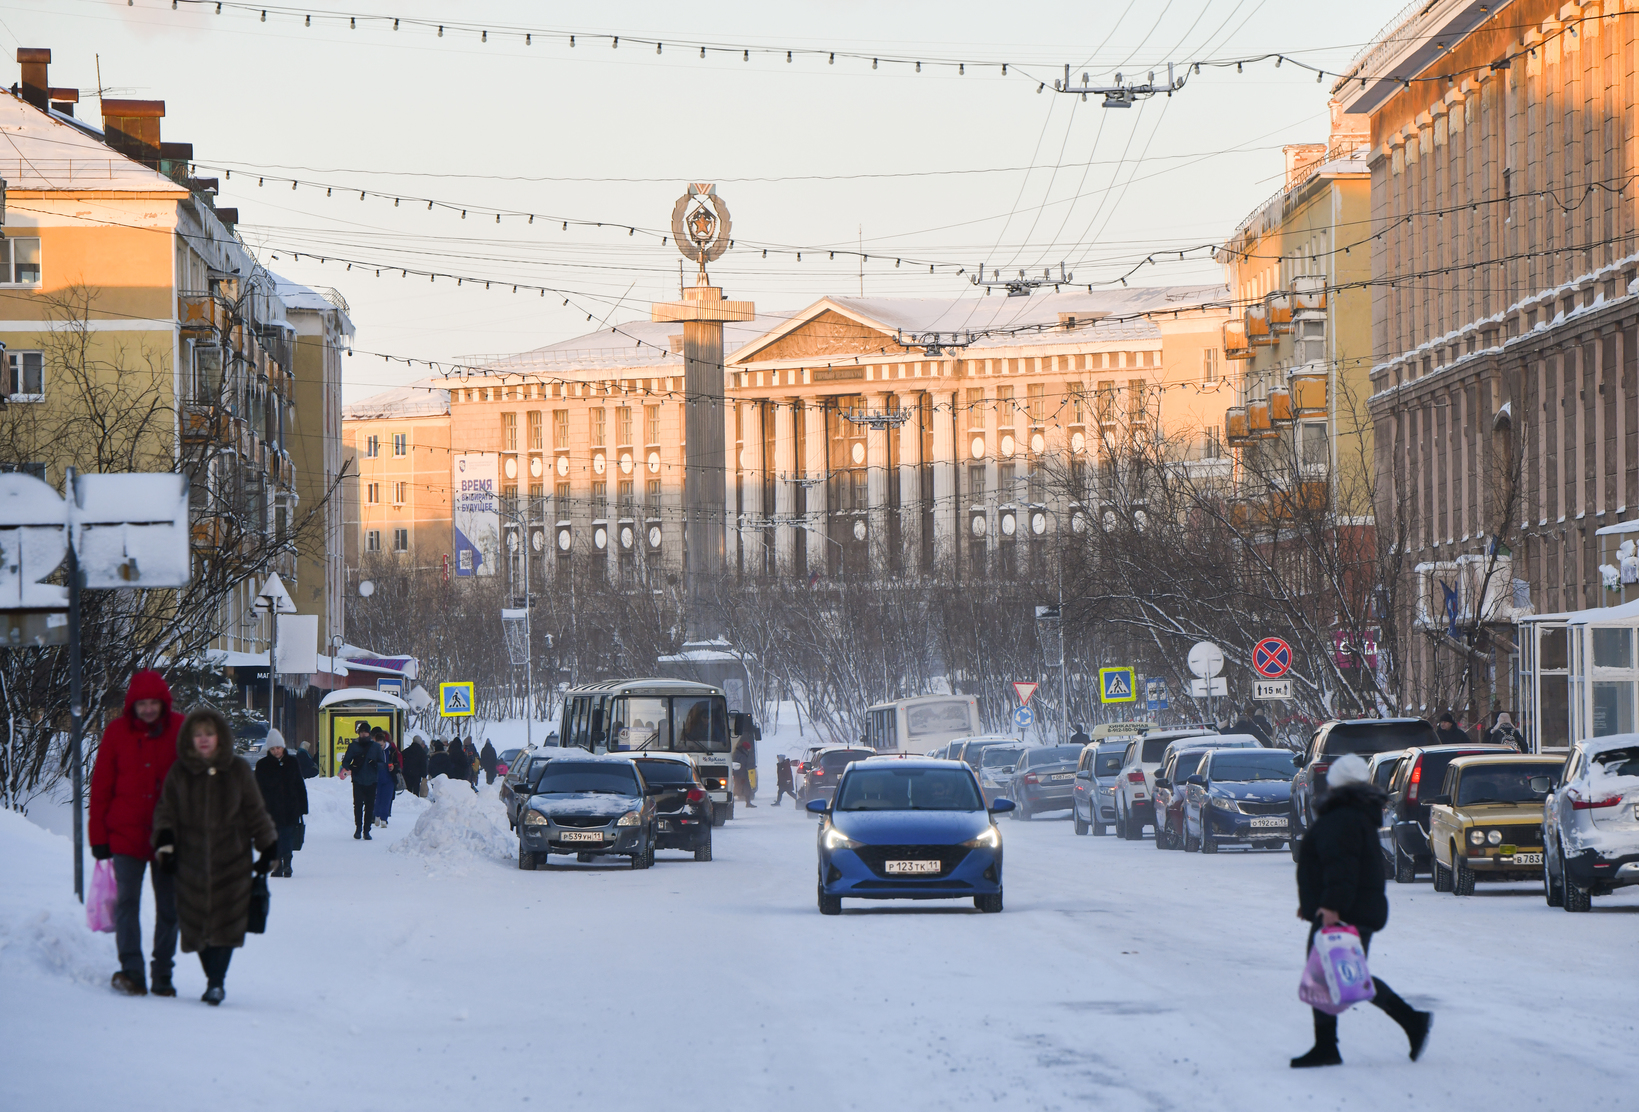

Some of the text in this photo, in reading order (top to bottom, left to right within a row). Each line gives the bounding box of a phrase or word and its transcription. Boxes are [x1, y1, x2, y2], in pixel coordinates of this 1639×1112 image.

[461, 479, 492, 491] ВРЕМЯ
[461, 491, 494, 502] ВЫБИРАТЬ
[461, 502, 494, 513] БУДУЩЕЕ
[1264, 686, 1274, 694] 15
[888, 862, 926, 871] Р123ТК
